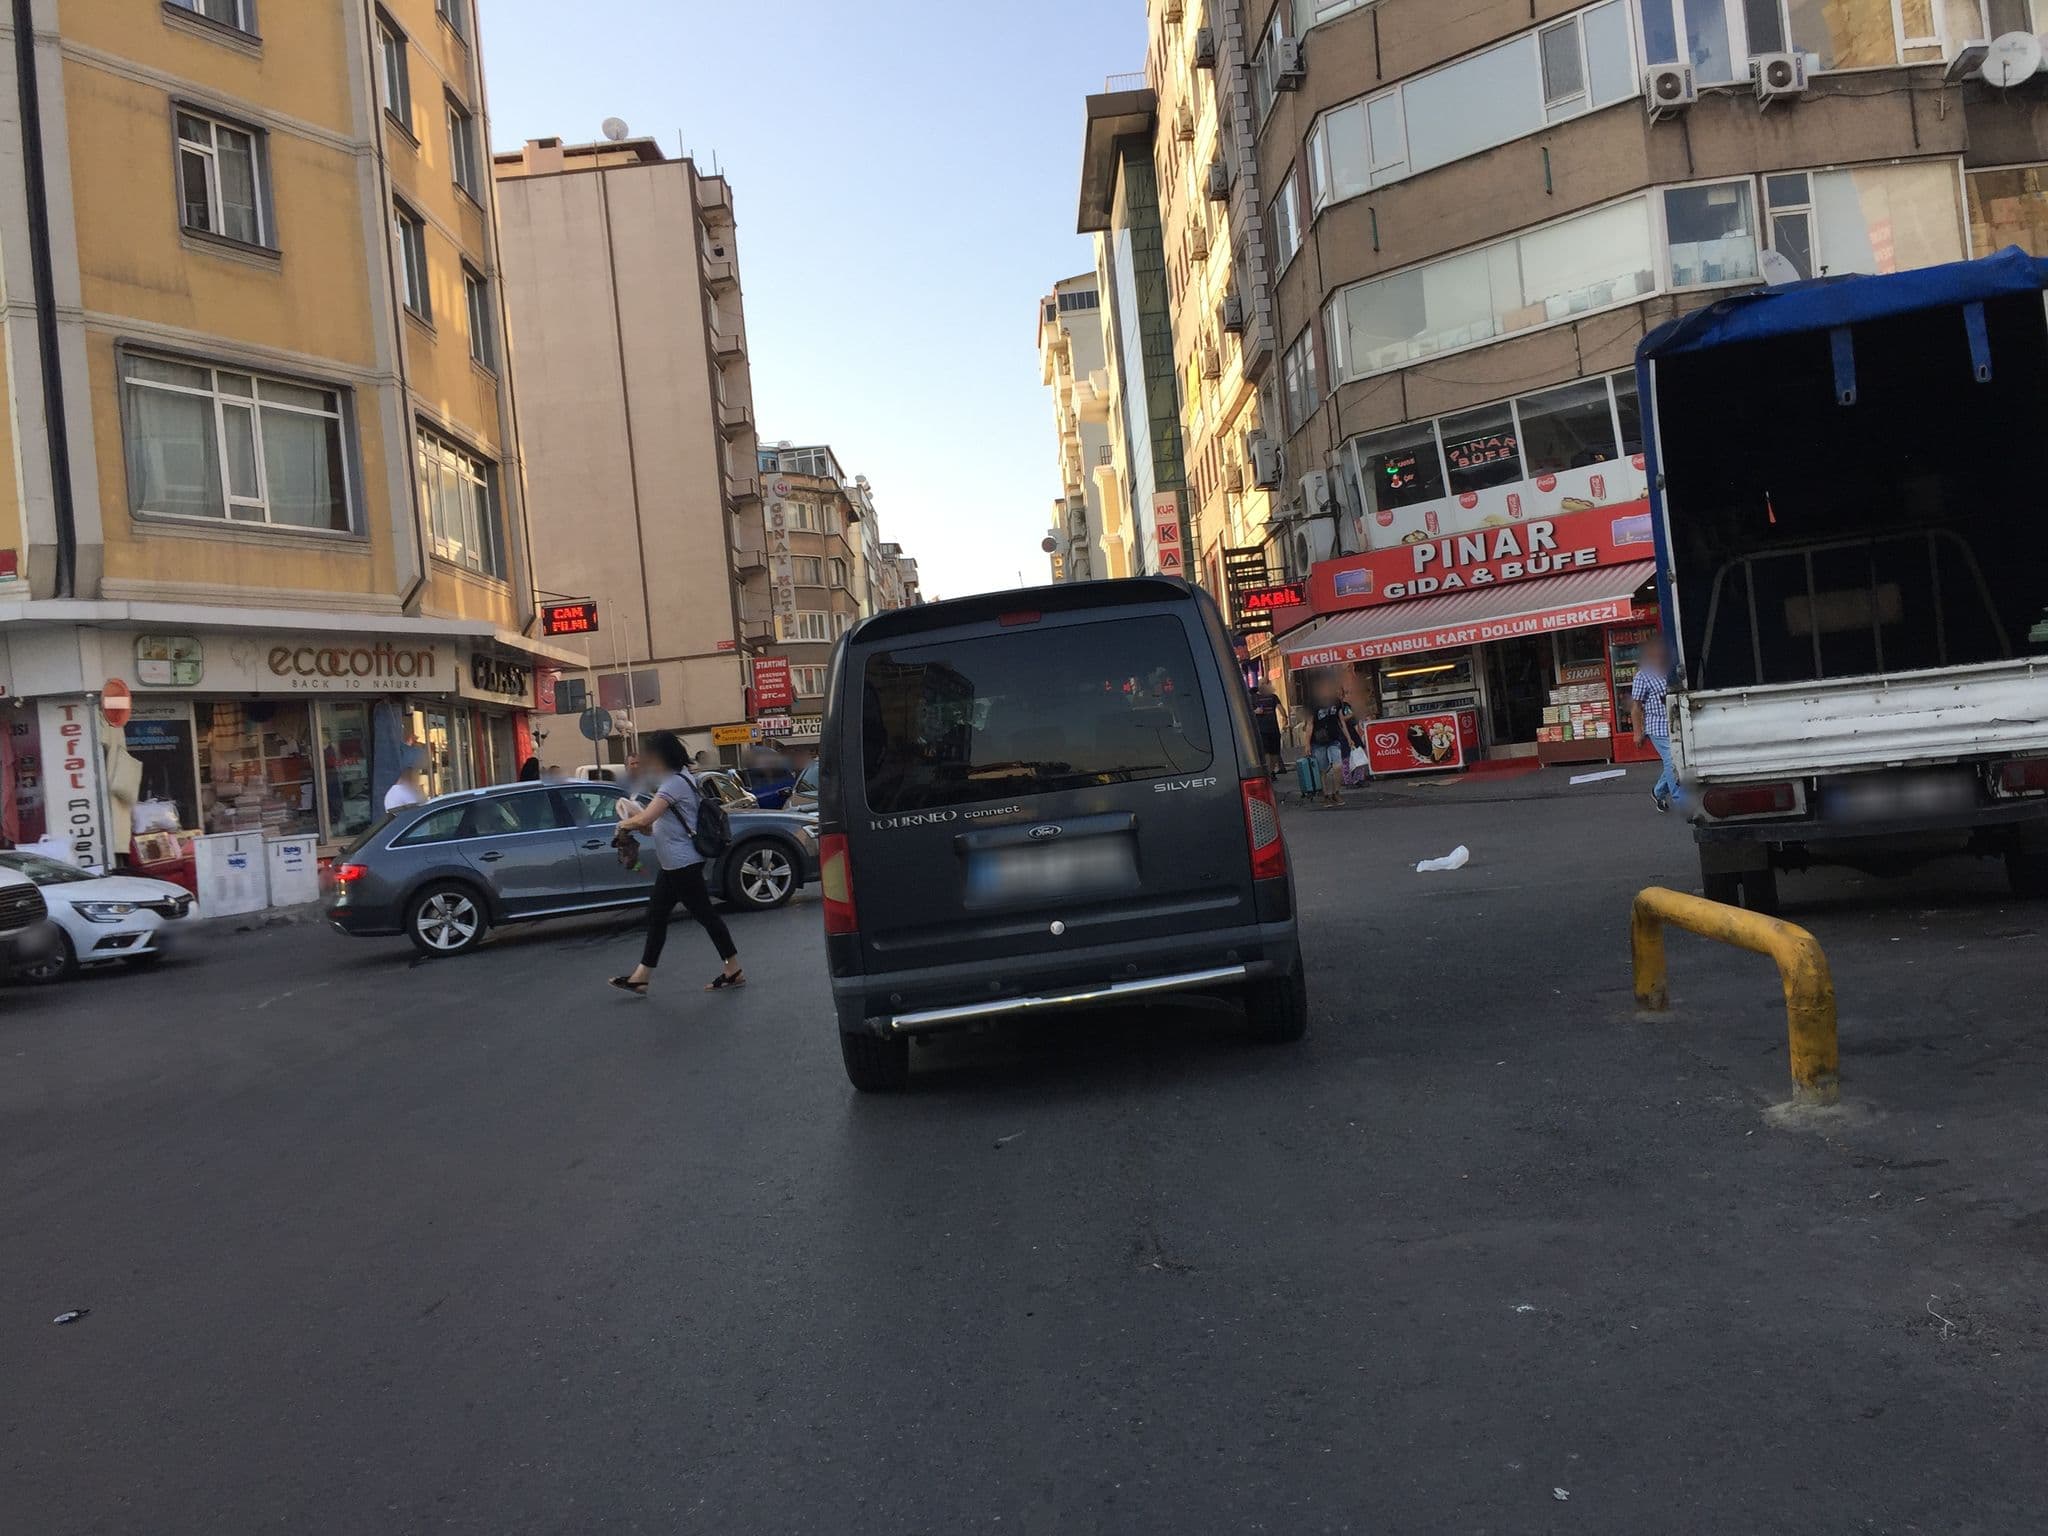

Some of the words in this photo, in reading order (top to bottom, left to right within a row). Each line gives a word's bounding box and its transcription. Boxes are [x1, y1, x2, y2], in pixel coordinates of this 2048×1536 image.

[1449, 437, 1516, 462] PINAR
[1156, 504, 1175, 515] KUR
[1411, 519, 1559, 573] PINAR
[1383, 573, 1465, 599] GIDA
[1469, 567, 1495, 585] &
[1500, 547, 1598, 578] BÜFE
[1247, 589, 1300, 608] AKBİL
[553, 607, 584, 619] CAM
[1301, 648, 1342, 667] AKBİL
[1346, 648, 1356, 659] &
[1360, 635, 1433, 658] İSTANBUL
[1435, 629, 1477, 647] KART
[1481, 619, 1538, 640] DOLUM
[1542, 602, 1618, 629] MERKEZİ
[292, 679, 330, 689] BACK
[345, 679, 361, 689] TO
[373, 679, 418, 689] NATURE
[1154, 777, 1217, 793] SILVER
[870, 810, 957, 831] TOURNEO
[964, 804, 1021, 819] connect
